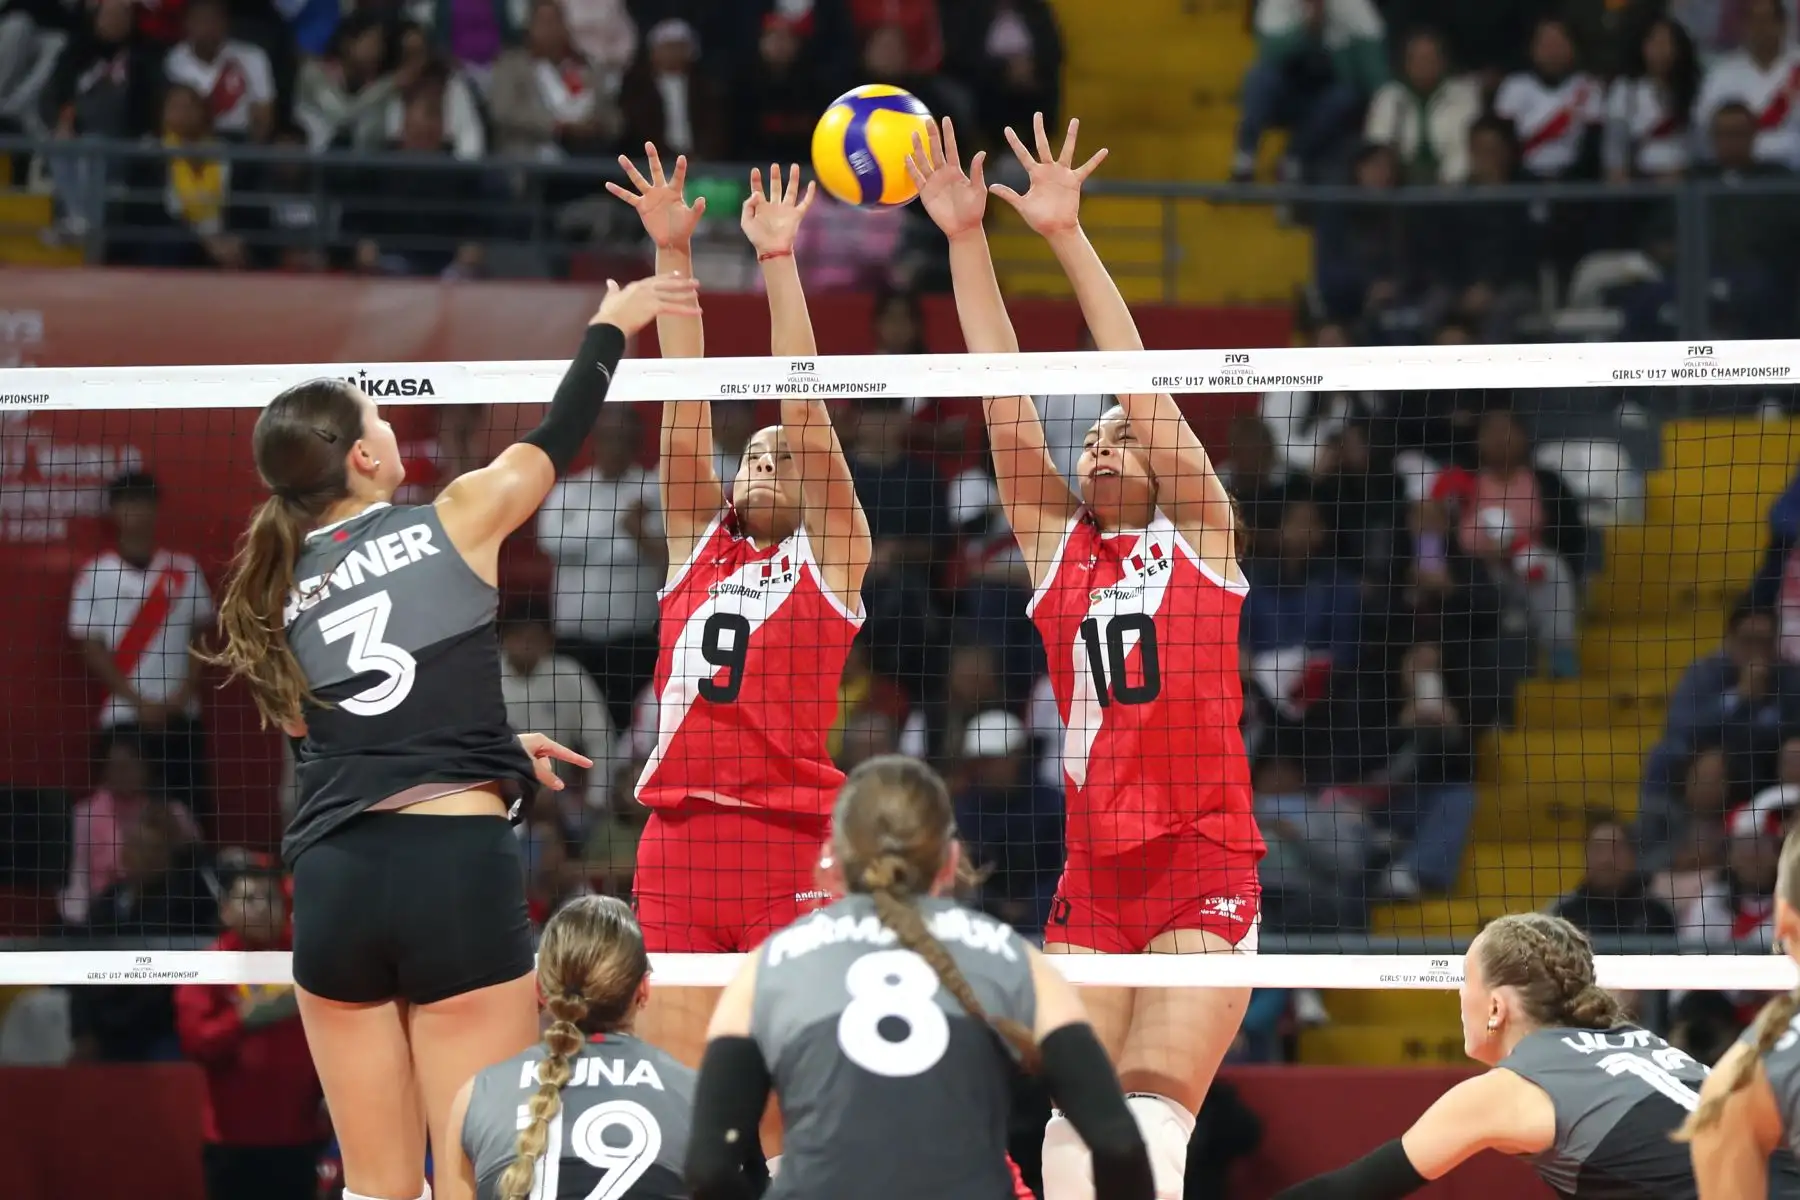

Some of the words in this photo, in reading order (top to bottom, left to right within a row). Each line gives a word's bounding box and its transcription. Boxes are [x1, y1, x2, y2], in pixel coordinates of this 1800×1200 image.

[1185, 376, 1204, 386] U17
[1208, 375, 1244, 386] WORLD
[1247, 375, 1324, 386] CHAMPIONSHIP
[1647, 369, 1667, 379] U17
[1671, 368, 1708, 378] WORLD
[1711, 367, 1791, 378] CHAMPIONSHIP
[338, 369, 436, 397] IKASA
[753, 384, 772, 394] U17
[775, 383, 809, 393] WORLD
[812, 382, 888, 393] CHAMPIONSHIP
[760, 572, 793, 587] PER
[720, 583, 763, 600] SPORADE
[318, 589, 418, 716] 3
[698, 612, 751, 704] 9
[1080, 612, 1162, 708] 10
[124, 971, 147, 979] WORLD
[1419, 975, 1444, 983] WORLD
[837, 949, 950, 1077] 8
[516, 1099, 662, 1200] 19
